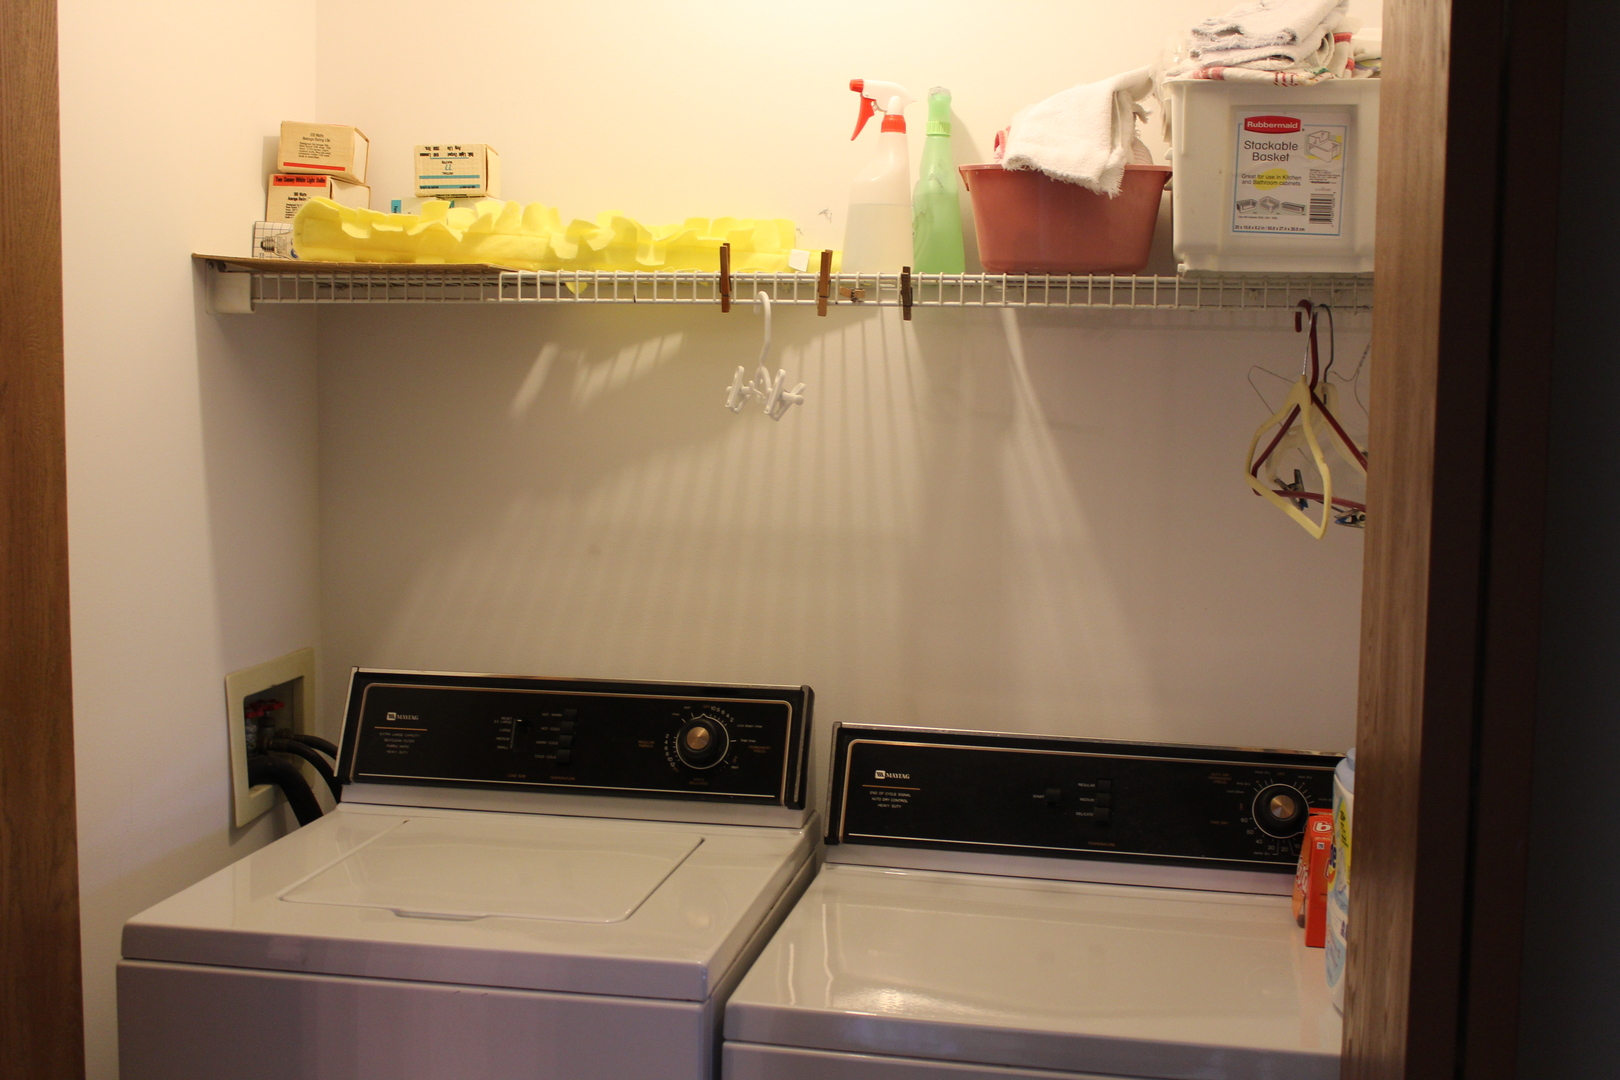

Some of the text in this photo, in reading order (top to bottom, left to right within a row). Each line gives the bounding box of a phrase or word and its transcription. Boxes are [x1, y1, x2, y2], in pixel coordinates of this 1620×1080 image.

[1247, 121, 1298, 129] Rubbermaid
[1244, 140, 1298, 150] Stackable
[1252, 152, 1290, 162] Basket
